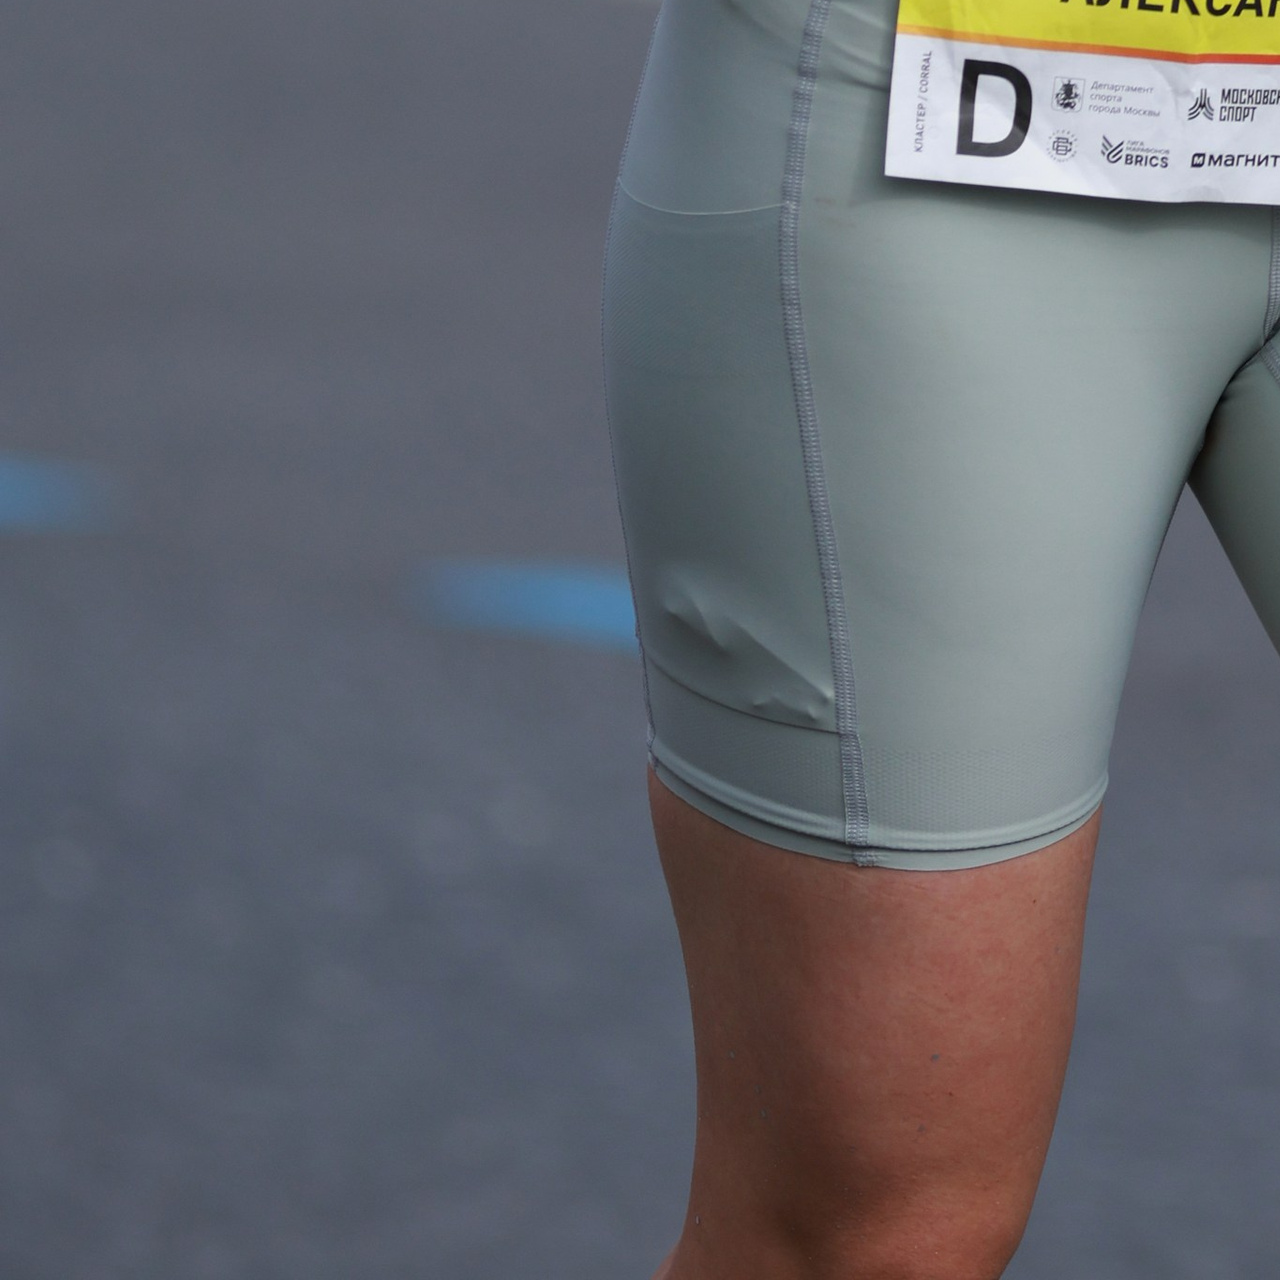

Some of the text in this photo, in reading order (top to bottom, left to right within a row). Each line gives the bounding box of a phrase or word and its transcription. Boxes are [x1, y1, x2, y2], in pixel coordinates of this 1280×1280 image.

[919, 50, 932, 93] CORRAL
[1090, 80, 1154, 94] Департамент
[1090, 93, 1122, 103] спорта
[956, 58, 1032, 158] D
[1088, 104, 1160, 117] города Москвы
[1219, 106, 1257, 122] СПОРТ
[914, 103, 926, 153] КЛАСТЕР
[1125, 153, 1168, 168] BRICS
